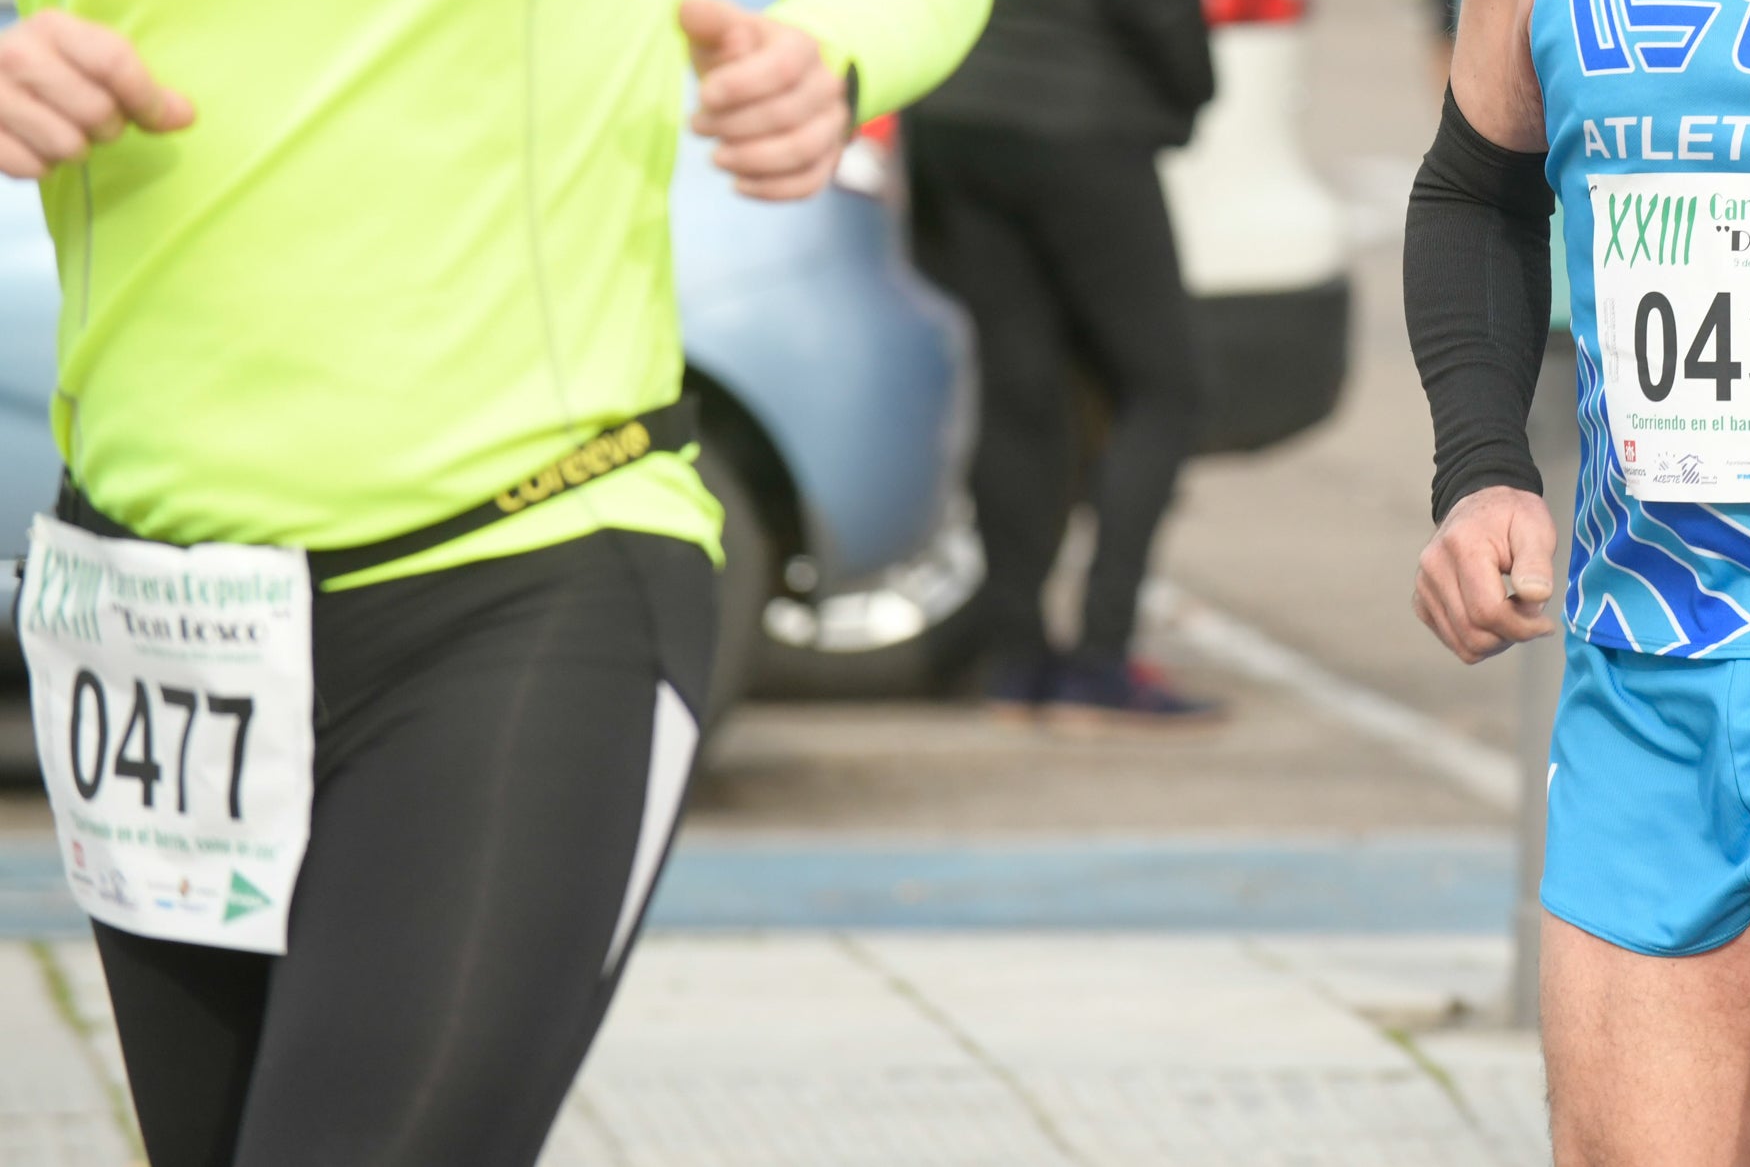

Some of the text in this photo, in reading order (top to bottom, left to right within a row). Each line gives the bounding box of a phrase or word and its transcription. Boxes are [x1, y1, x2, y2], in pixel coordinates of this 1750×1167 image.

[1604, 192, 1697, 269] XXIII
[1691, 418, 1706, 430] en
[1712, 415, 1724, 431] el
[70, 670, 253, 821] 0477
